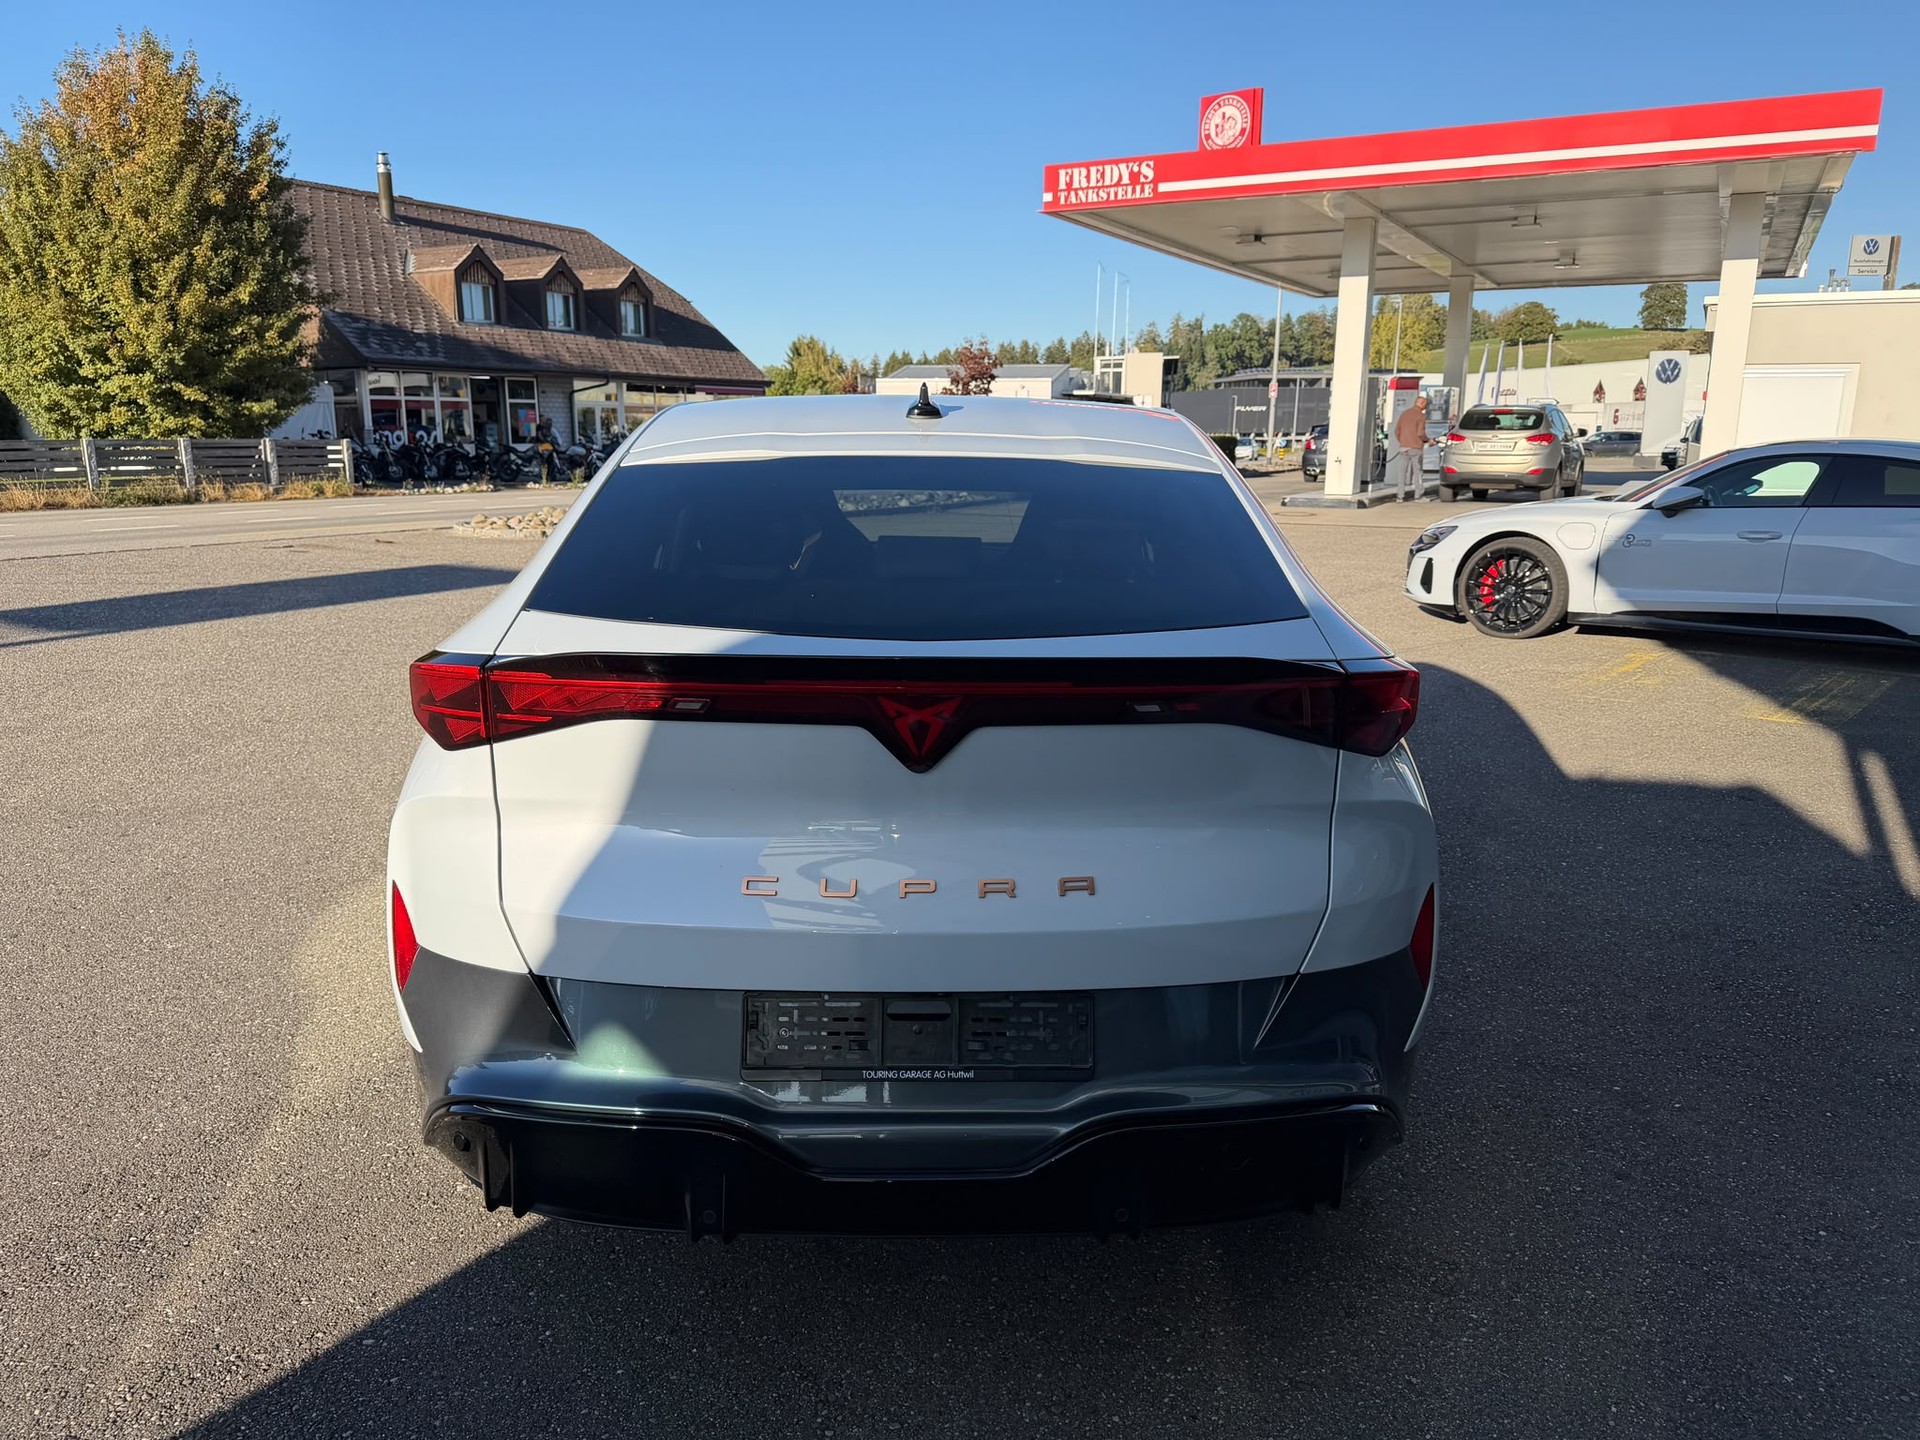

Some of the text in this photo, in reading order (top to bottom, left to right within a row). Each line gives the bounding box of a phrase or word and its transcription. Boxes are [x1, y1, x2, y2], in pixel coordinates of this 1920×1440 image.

[1058, 160, 1154, 190] FREDY'S
[1058, 184, 1153, 205] TANKSTELLE
[740, 875, 1096, 899] CUPRA
[862, 1070, 975, 1079] TOURING GARAGE AG Huttwil
